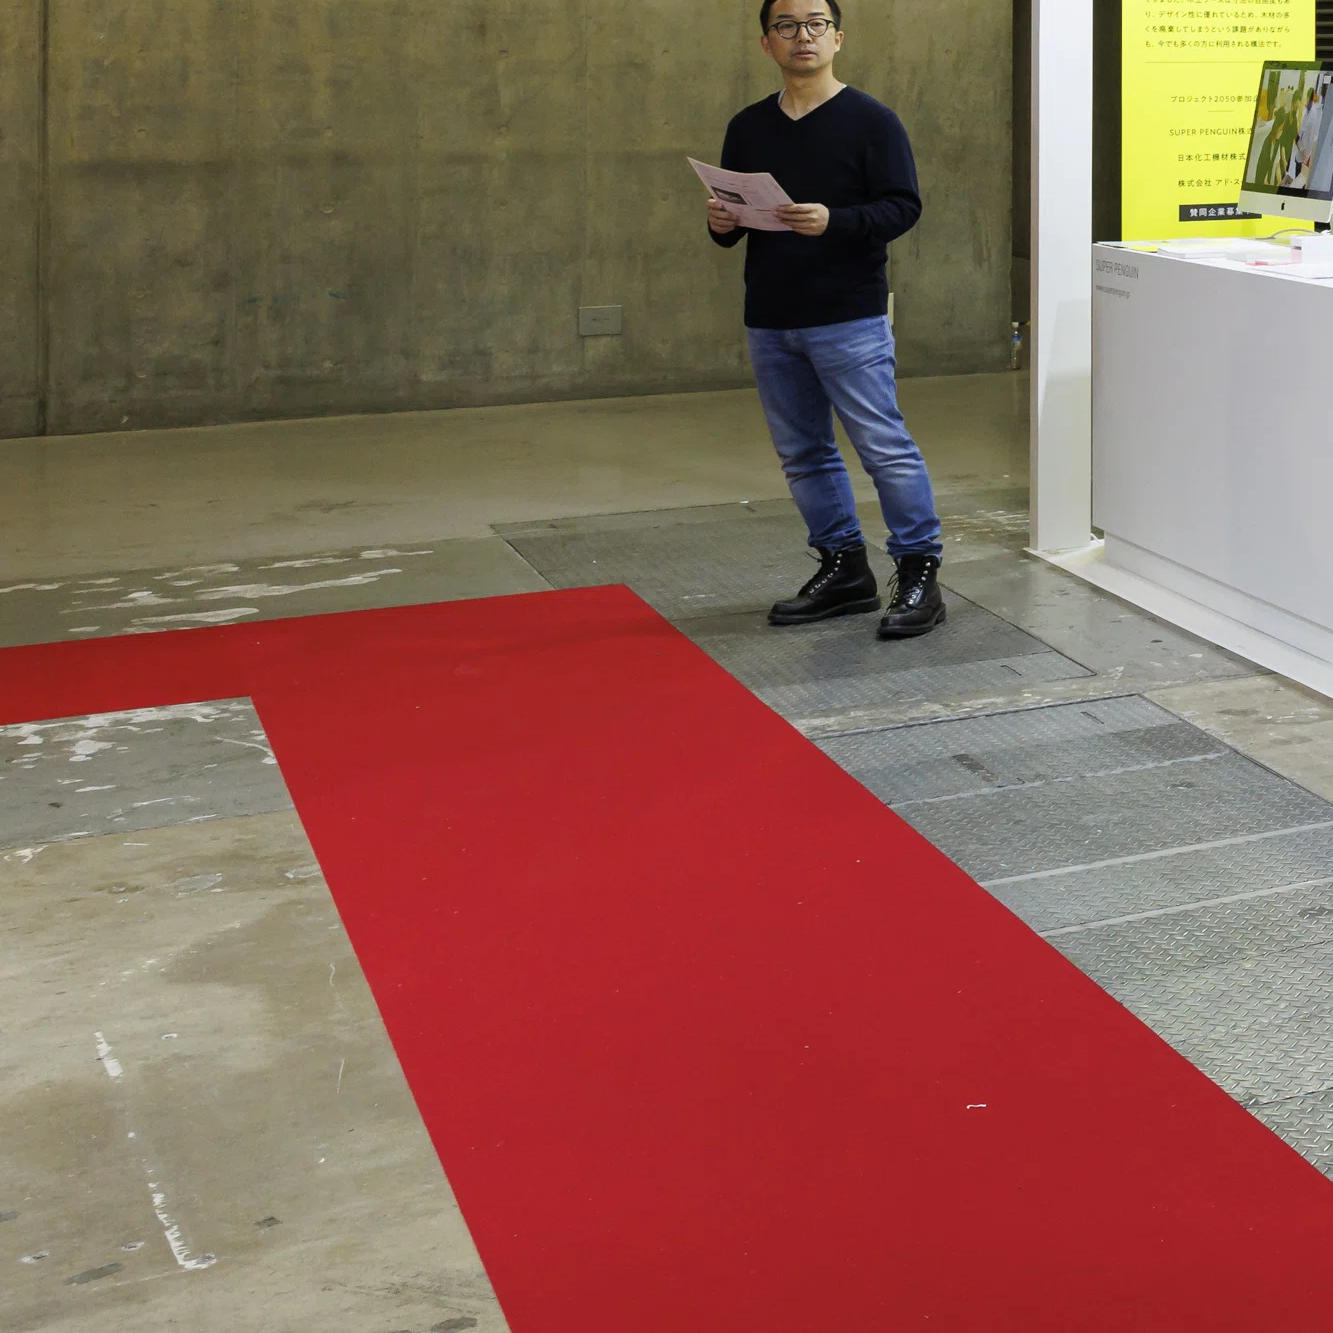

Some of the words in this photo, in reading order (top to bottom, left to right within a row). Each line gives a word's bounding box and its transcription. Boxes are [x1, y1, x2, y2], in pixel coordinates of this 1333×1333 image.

[1169, 128, 1196, 136] SUPER
[1178, 179, 1212, 187] 株式会社
